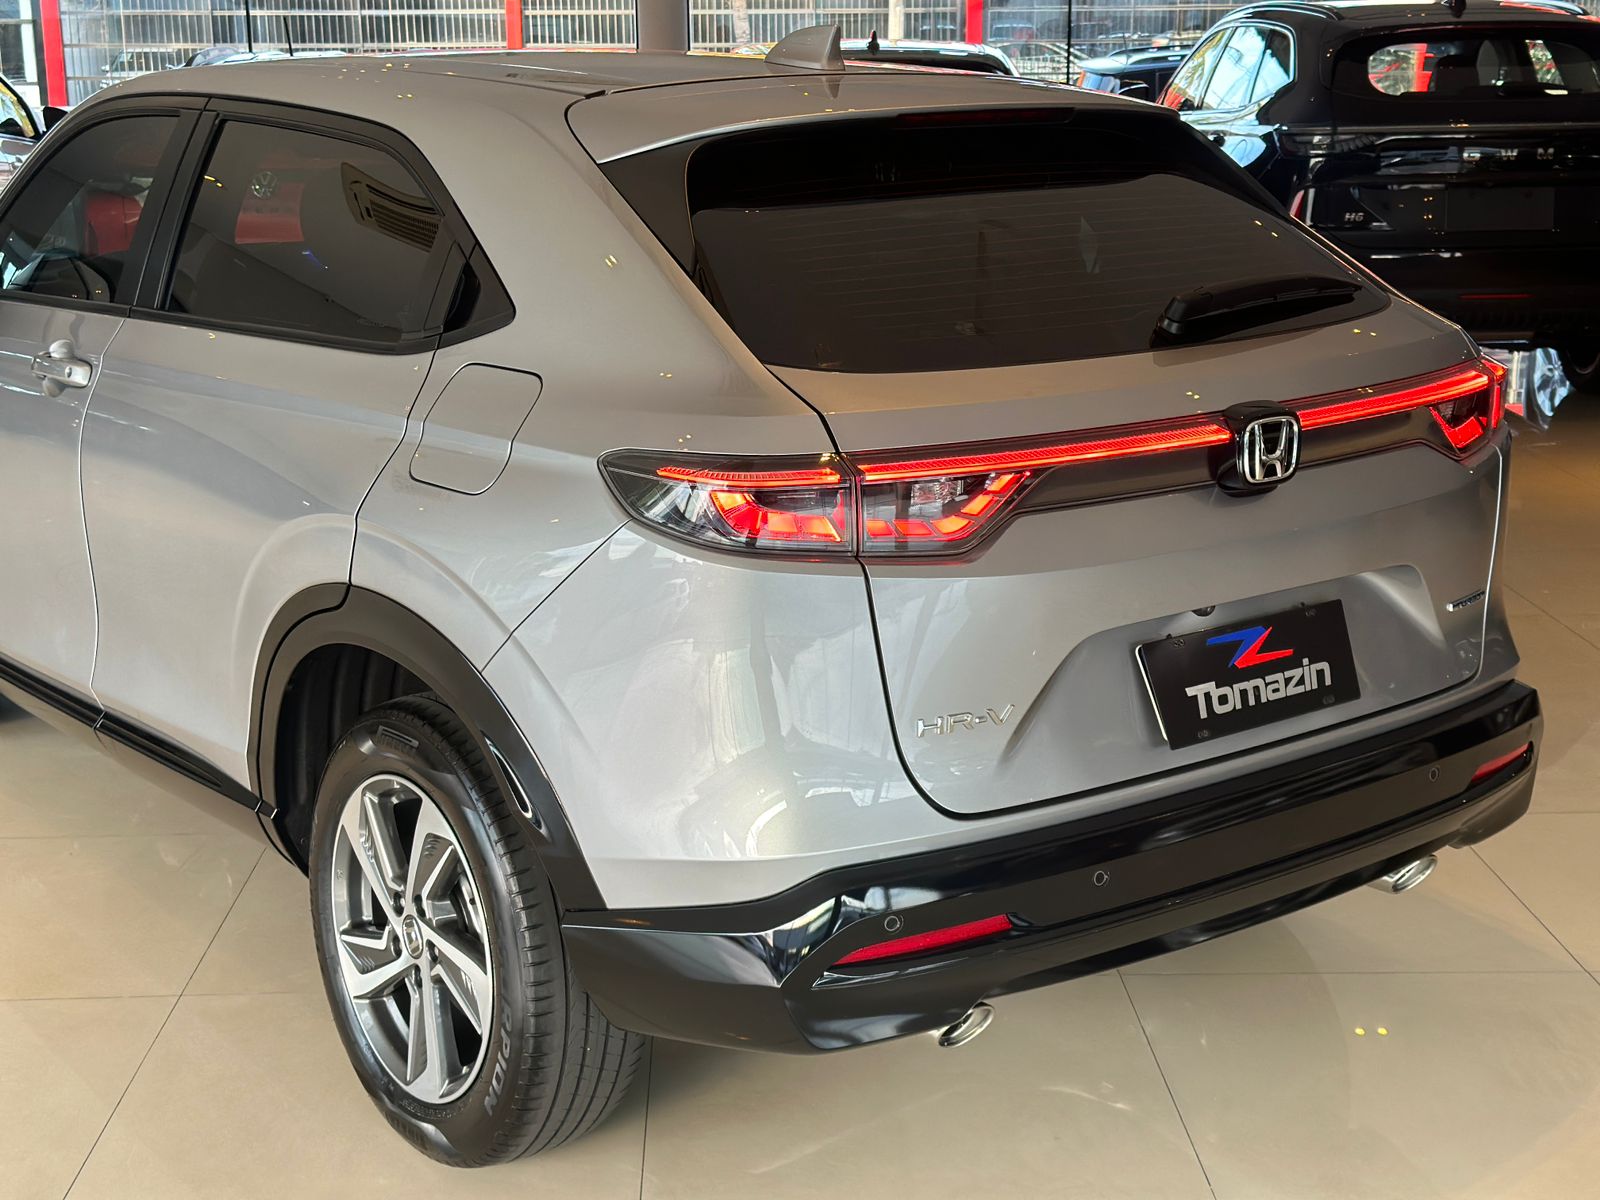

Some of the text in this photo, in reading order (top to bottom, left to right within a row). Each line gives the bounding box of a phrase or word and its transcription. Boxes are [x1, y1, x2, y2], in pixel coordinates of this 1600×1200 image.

[1344, 212, 1365, 222] H6
[1185, 657, 1332, 720] Tomazin
[916, 704, 1015, 738] HR-V
